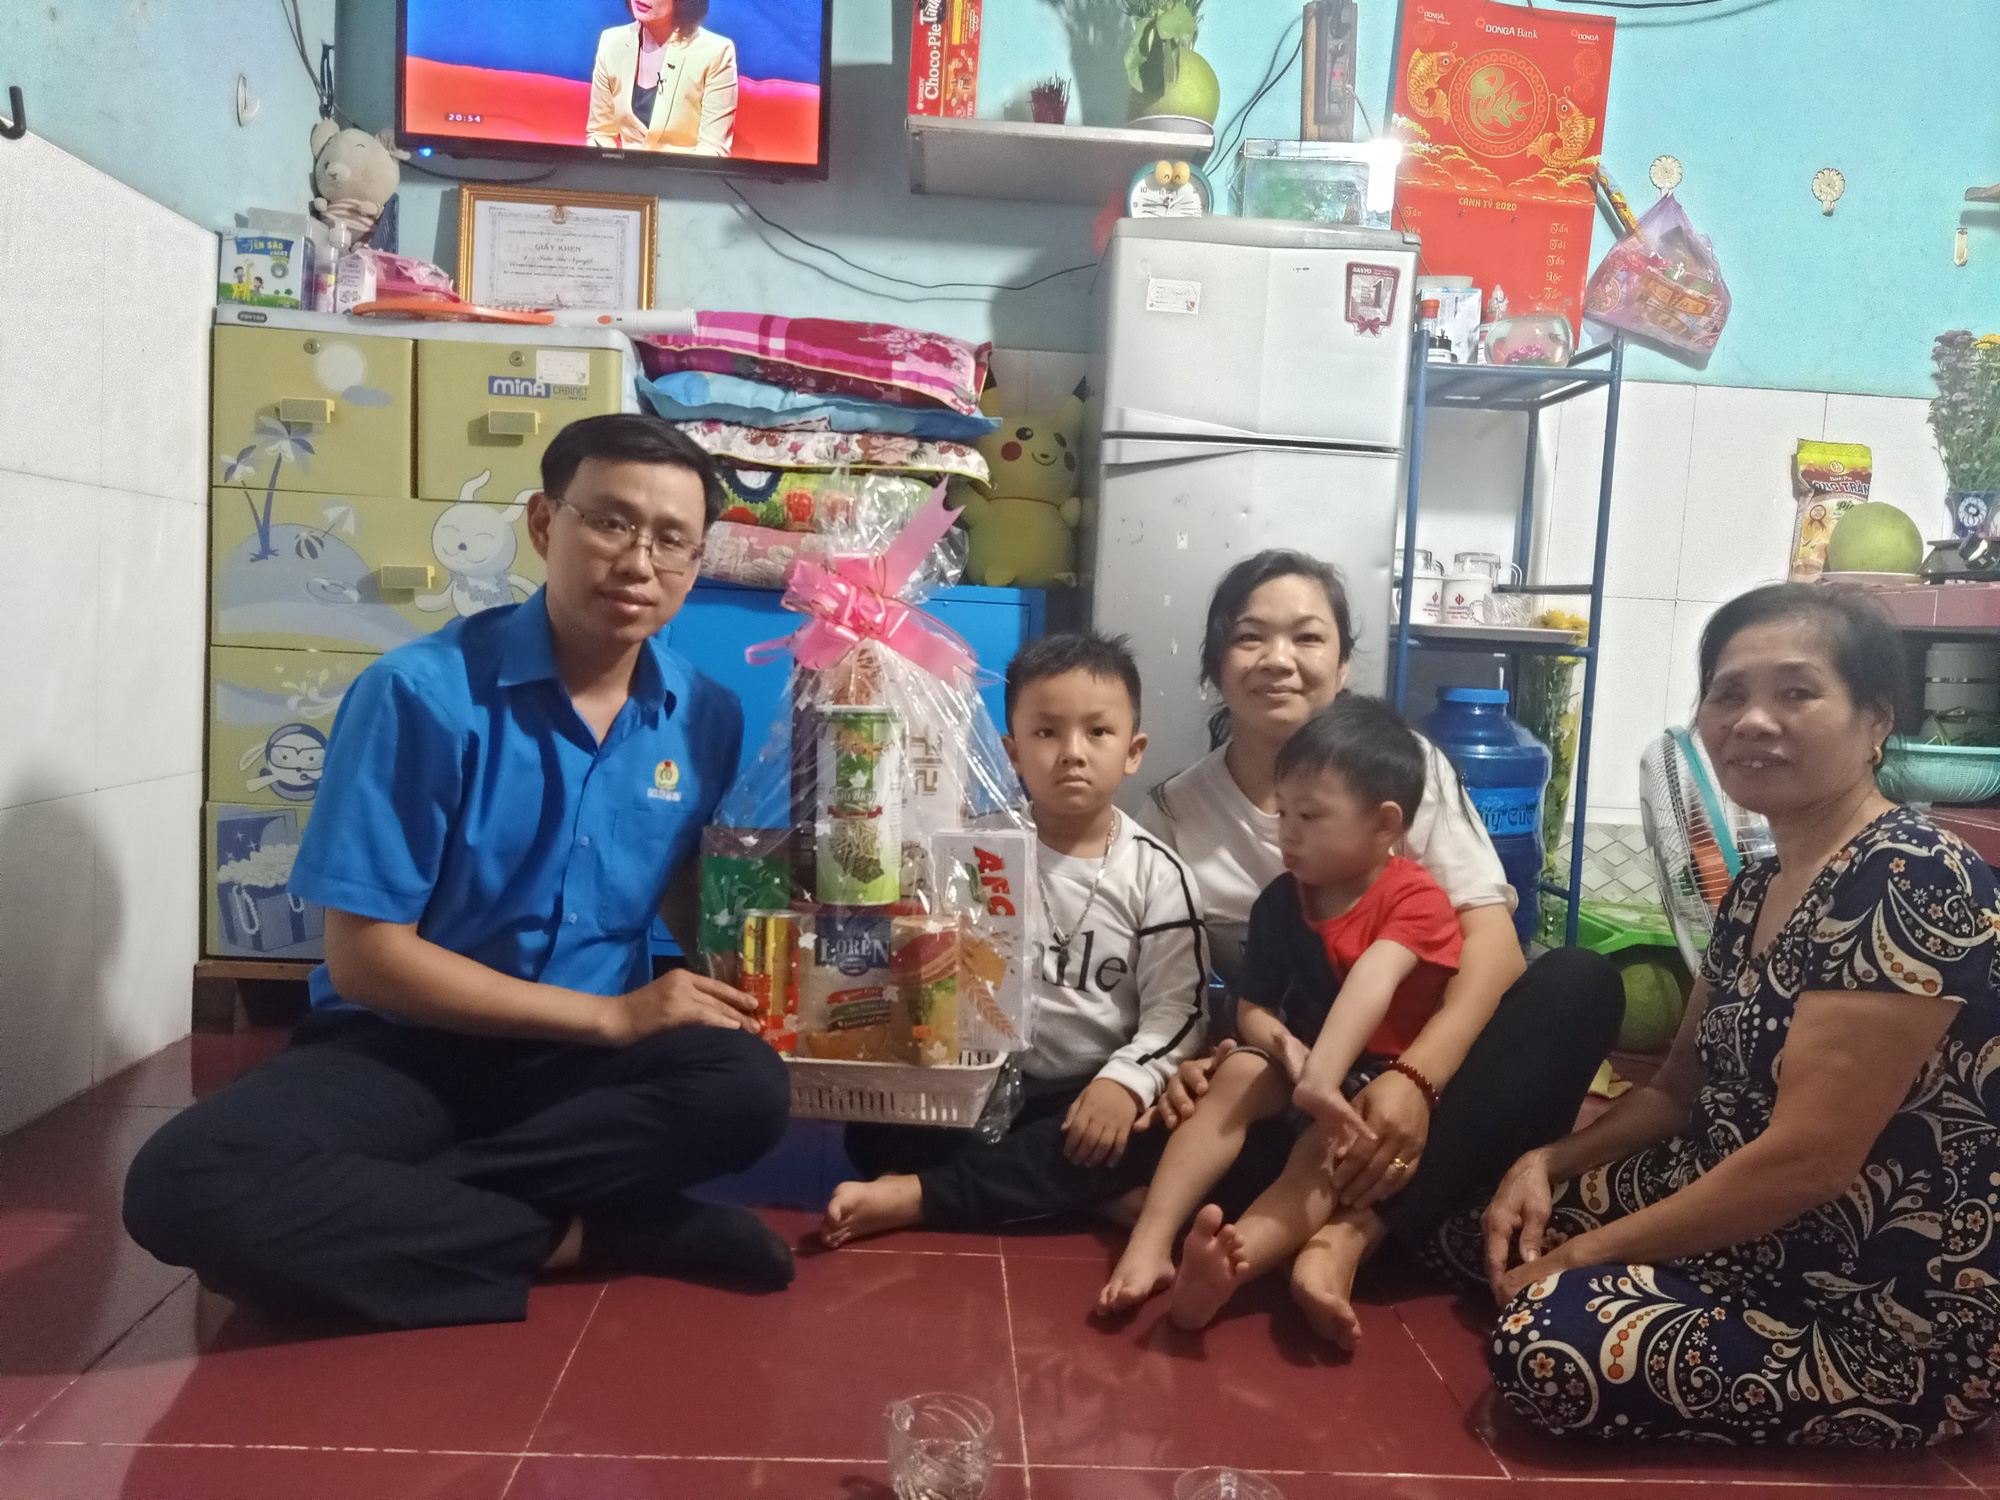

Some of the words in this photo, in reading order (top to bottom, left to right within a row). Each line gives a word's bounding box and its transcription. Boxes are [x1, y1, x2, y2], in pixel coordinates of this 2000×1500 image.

[1517, 27, 1538, 39] Bank
[448, 114, 481, 123] 20:54
[1458, 197, 1481, 207] CANH
[1495, 202, 1517, 211] 2020
[535, 242, 555, 251] GIẤY
[974, 846, 1016, 917] AFC
